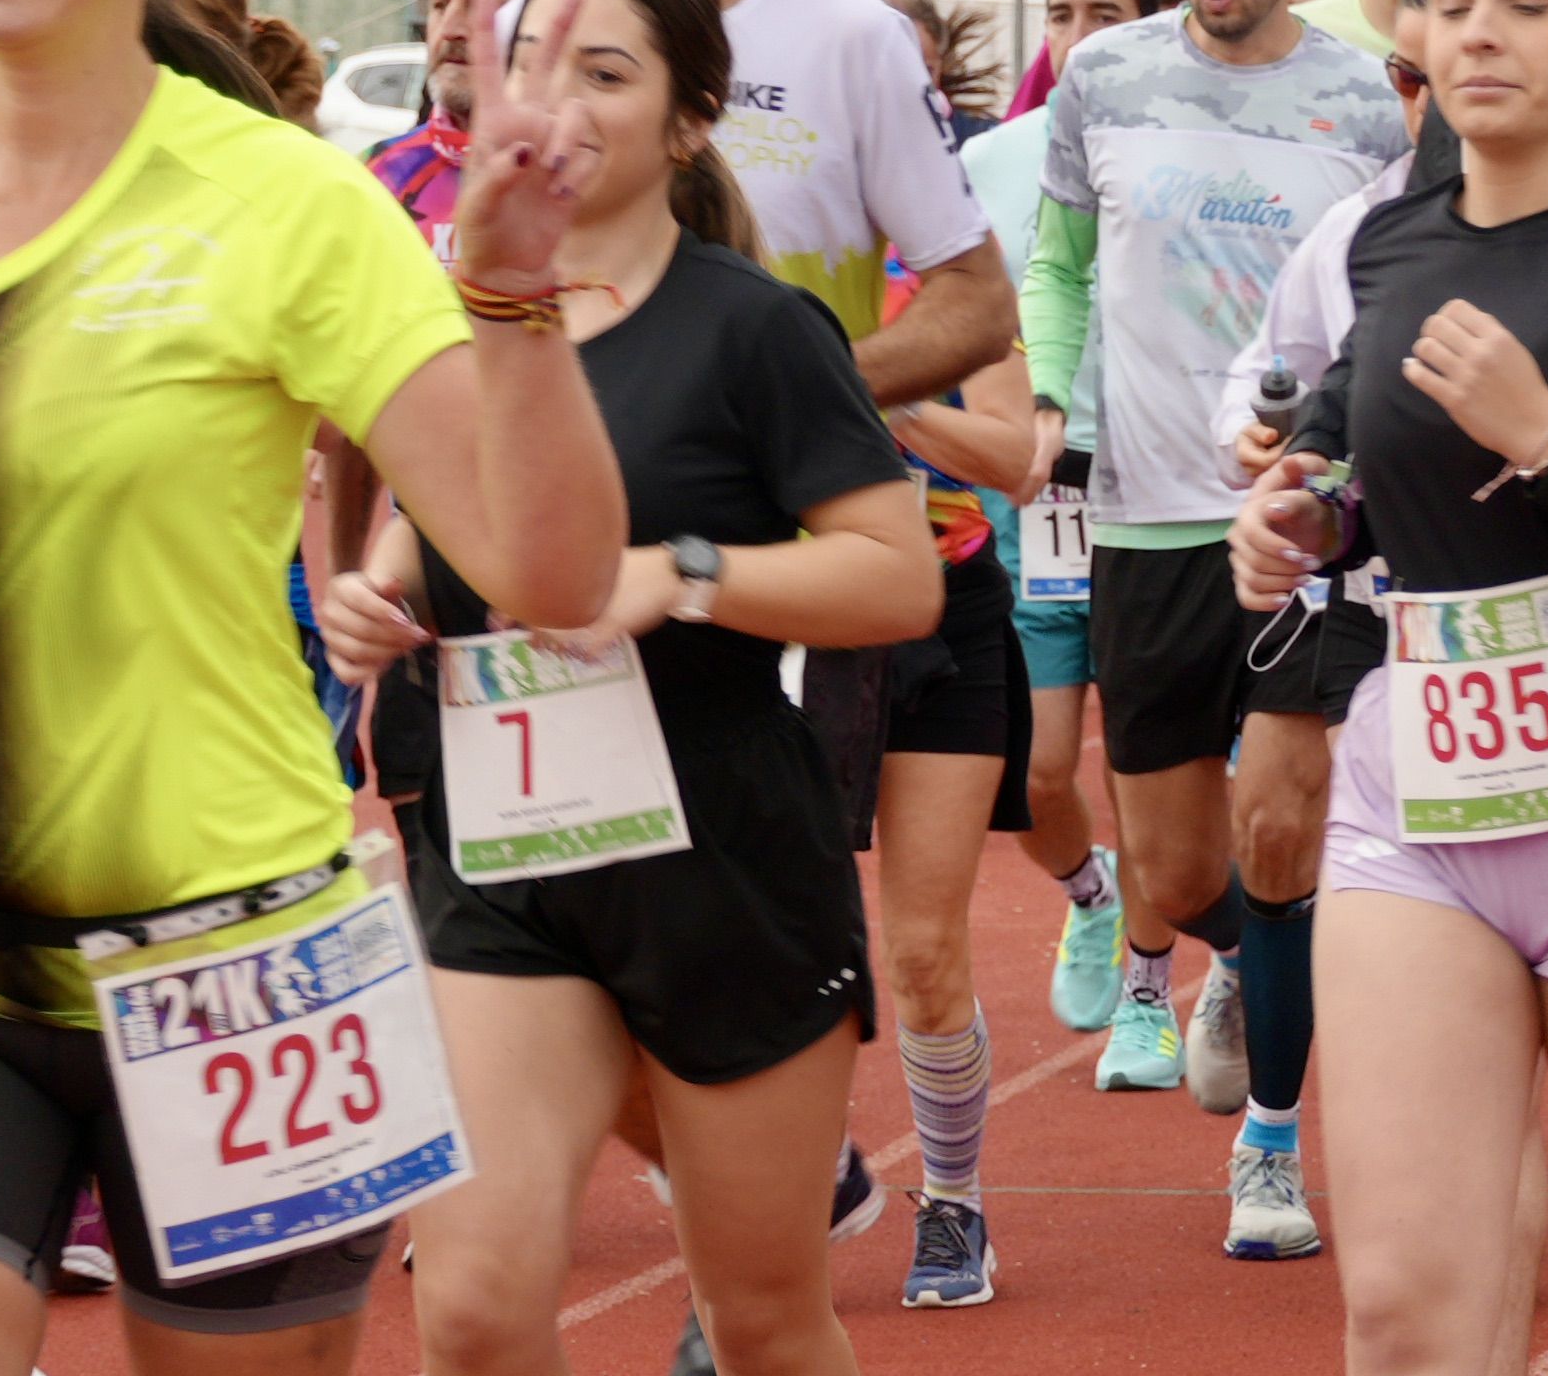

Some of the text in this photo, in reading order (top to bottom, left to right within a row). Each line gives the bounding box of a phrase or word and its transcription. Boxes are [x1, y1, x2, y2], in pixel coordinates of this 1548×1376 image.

[1043, 508, 1087, 557] 11
[152, 956, 274, 1049] 21K
[204, 1012, 384, 1166] 223
